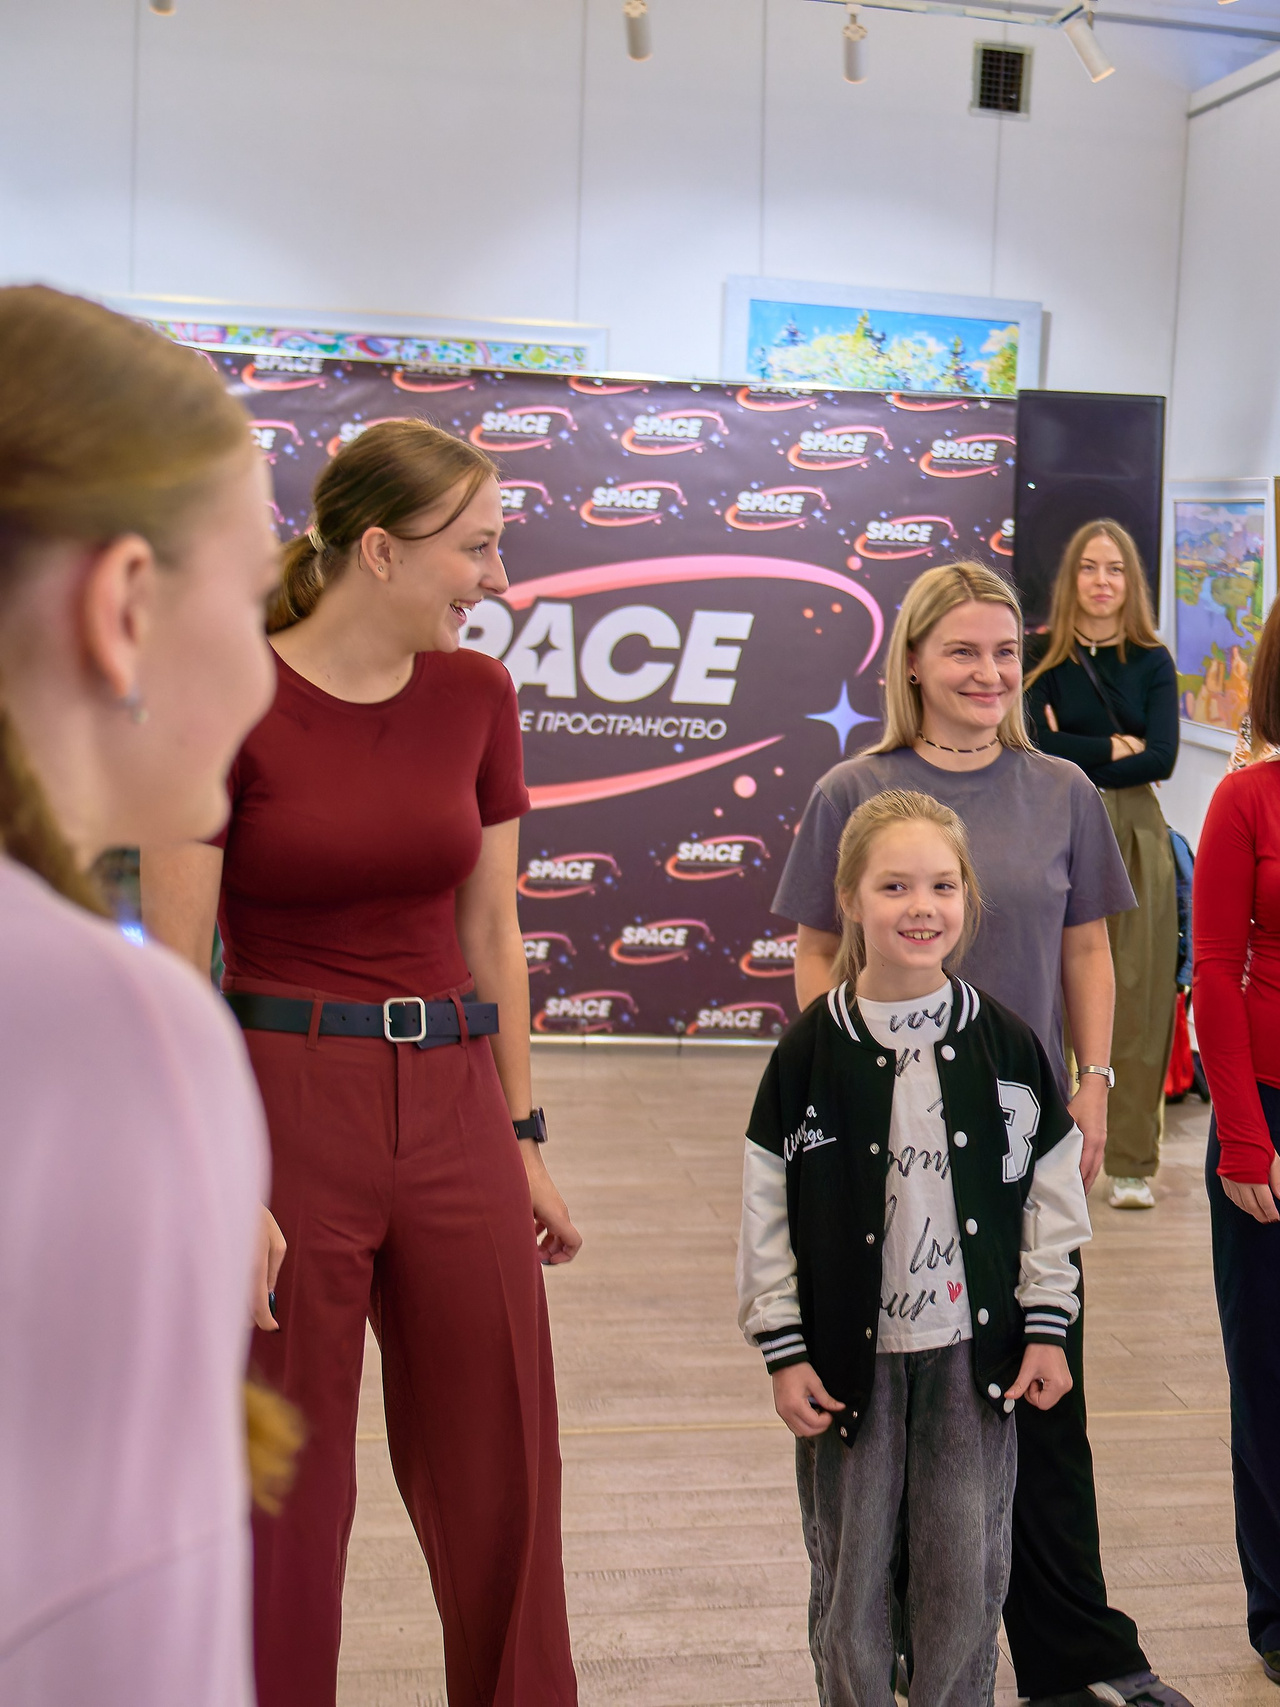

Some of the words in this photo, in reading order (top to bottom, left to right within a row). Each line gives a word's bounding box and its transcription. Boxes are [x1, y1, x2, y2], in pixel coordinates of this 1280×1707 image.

[481, 411, 551, 435] SPACE
[633, 415, 703, 438] SPACE
[799, 430, 868, 454] SPACE
[930, 439, 998, 461] SPACE
[592, 487, 661, 510] SPACE
[737, 491, 805, 513] SPACE
[866, 521, 933, 543] SPACE
[459, 599, 755, 705] PACE
[536, 711, 728, 741] ПРОСТРАНСТВО
[677, 842, 744, 863] SPACE
[528, 859, 595, 880] SPACE
[621, 926, 688, 946] SPACE
[752, 940, 797, 958] SPAC
[546, 997, 612, 1018] SPACE
[698, 1009, 762, 1028] SPACE
